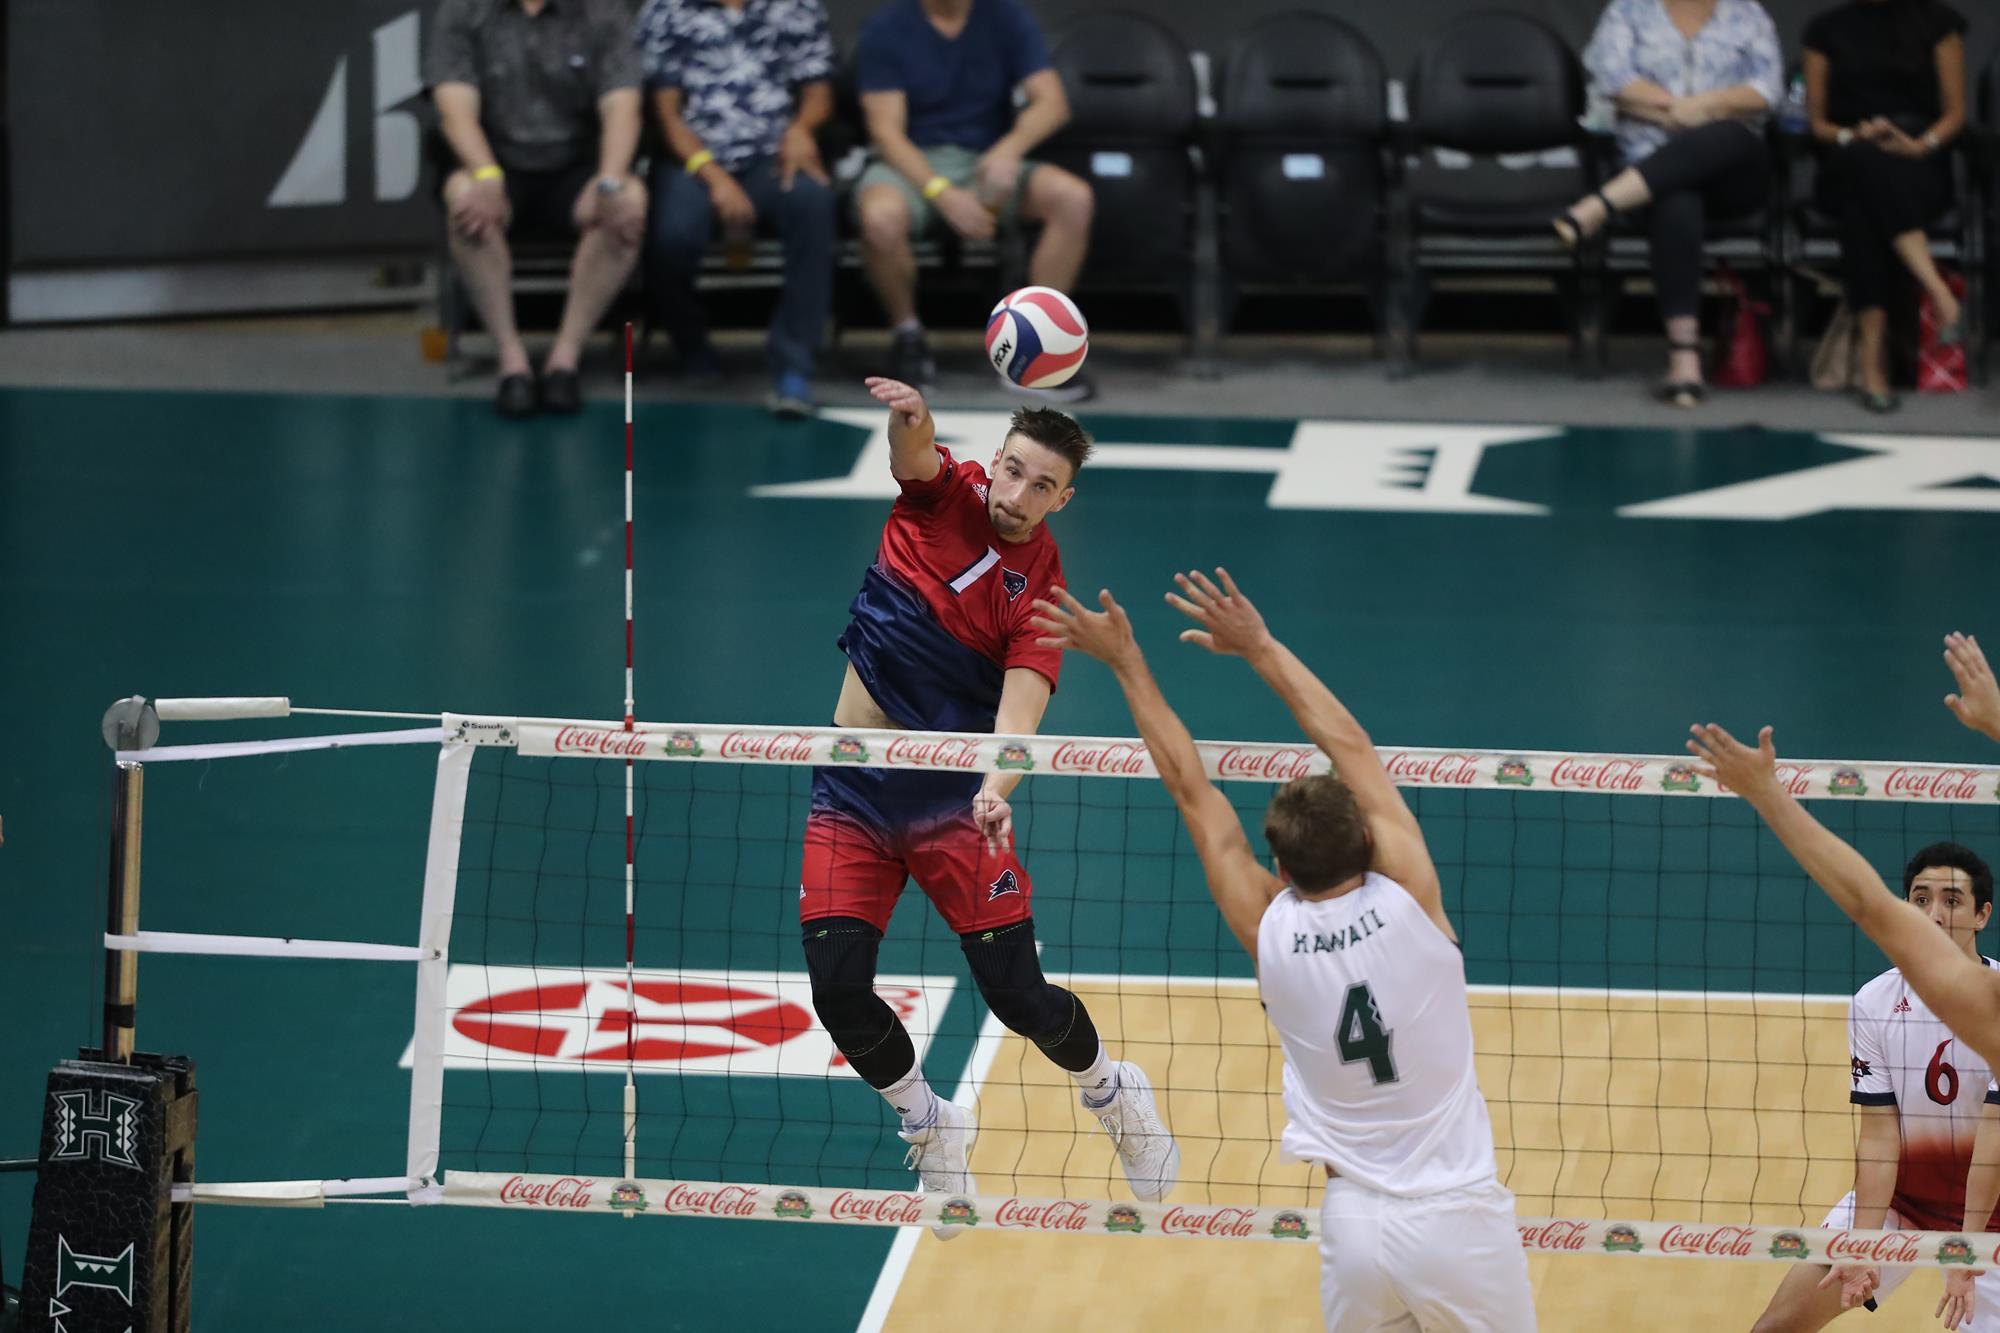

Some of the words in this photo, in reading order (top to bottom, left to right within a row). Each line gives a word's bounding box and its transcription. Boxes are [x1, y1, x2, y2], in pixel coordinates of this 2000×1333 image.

[555, 726, 647, 755] Coca-Cola
[720, 734, 813, 762] Coca-Cola
[886, 737, 978, 768] Coca-Cola
[1052, 741, 1145, 773] Coca-Cola
[1217, 749, 1314, 780] Coca-Cola
[1386, 752, 1479, 784] Coca-Cola
[1552, 759, 1644, 789] Coca-Cola
[1884, 768, 1978, 800] Coca-Cola
[1292, 906, 1386, 953] HAWAII
[1333, 979, 1400, 1086] 4
[1925, 1038, 1959, 1105] 6
[501, 1177, 594, 1207] Coca-Cola
[665, 1184, 757, 1216] Coca-Cola
[830, 1192, 923, 1222] Coca-Cola
[995, 1199, 1090, 1231] Coca-Cola
[1160, 1207, 1255, 1236] Coca-Cola
[1659, 1225, 1755, 1256] Coca-Cola
[1825, 1231, 1920, 1262] Coca-Cola
